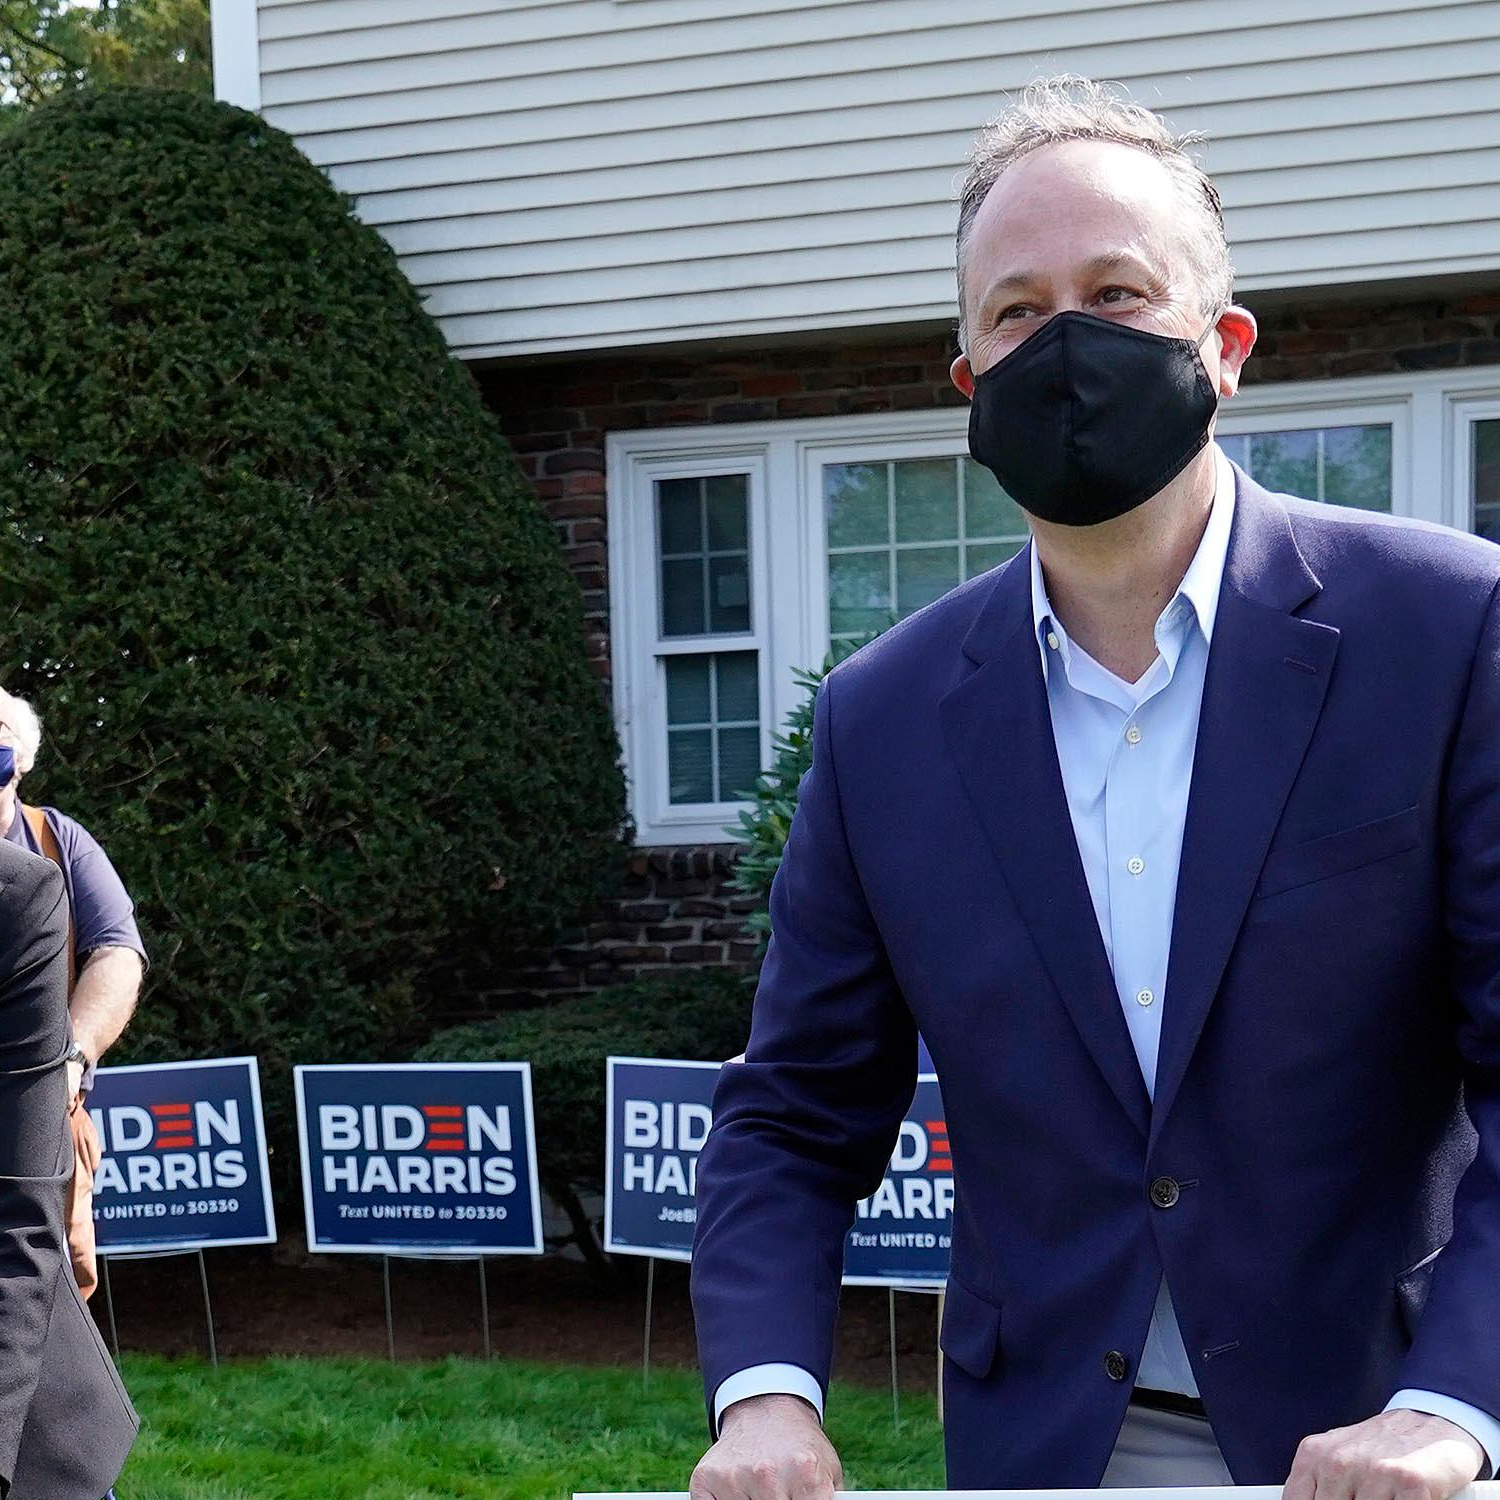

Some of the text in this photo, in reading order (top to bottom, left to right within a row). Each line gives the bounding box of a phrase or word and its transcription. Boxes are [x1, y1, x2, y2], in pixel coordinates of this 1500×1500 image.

[89, 1099, 241, 1152] IDEN
[319, 1104, 512, 1151] BIDEN
[624, 1099, 713, 1151] BID
[93, 1150, 248, 1195] ARRIS
[322, 1155, 517, 1196] HARRIS
[103, 1203, 167, 1220] UNITED
[171, 1203, 185, 1215] to
[187, 1199, 239, 1215] 30330
[338, 1204, 507, 1220] Text UNITED to 30330
[850, 1231, 951, 1248] Text UNITED to
